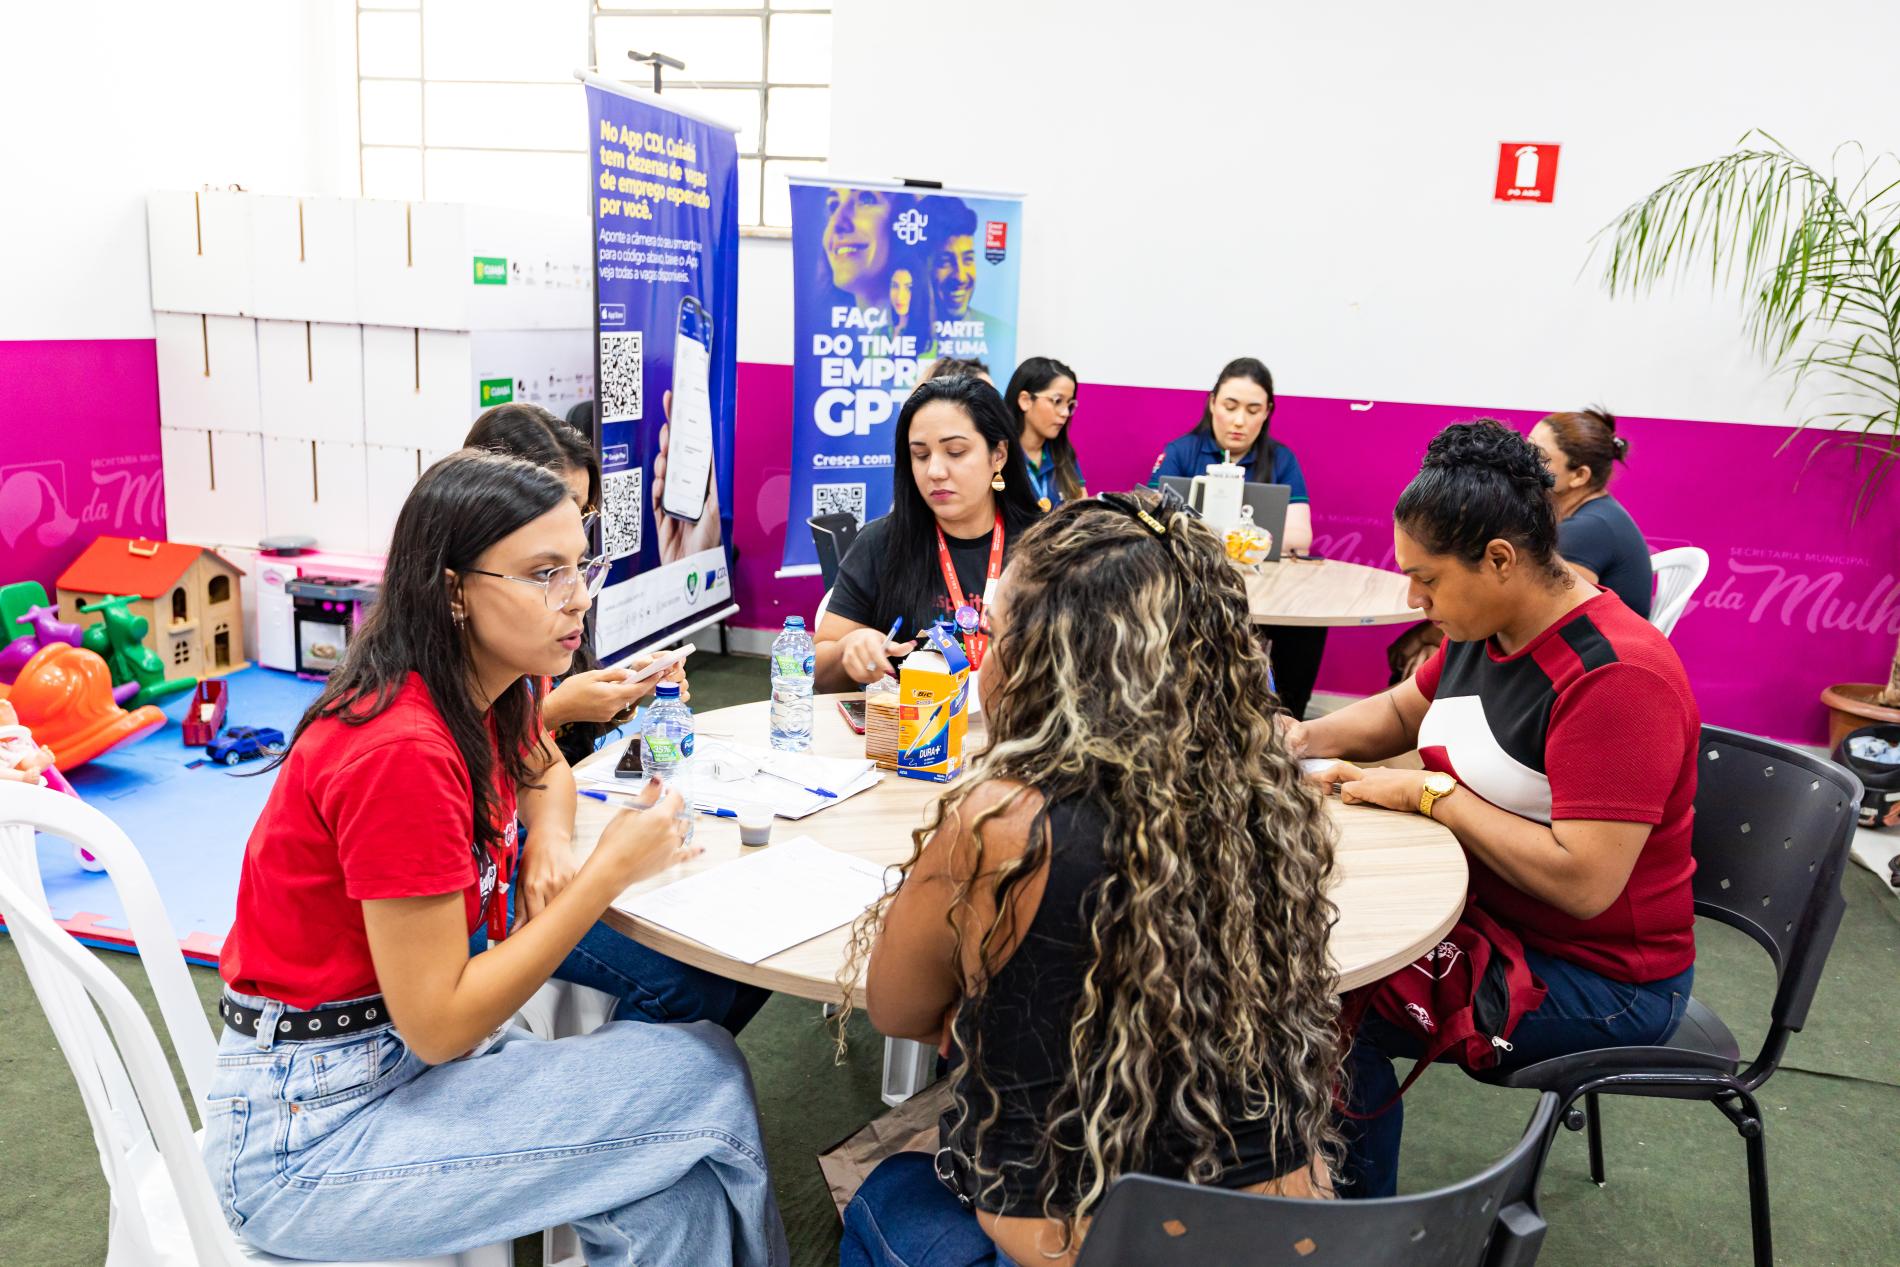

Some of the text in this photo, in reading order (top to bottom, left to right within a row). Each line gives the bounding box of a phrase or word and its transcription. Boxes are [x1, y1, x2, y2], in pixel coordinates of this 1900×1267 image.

[600, 119, 618, 143] No
[619, 125, 643, 153] App
[600, 145, 625, 169] tem
[626, 151, 668, 178] dezenas
[669, 160, 682, 181] de
[600, 168, 616, 191] de
[618, 176, 665, 203] emprego
[600, 197, 652, 220] por você.
[599, 227, 625, 244] Aponte
[600, 248, 616, 262] para
[617, 250, 622, 261] o
[679, 256, 685, 267] o
[599, 264, 615, 281] veja
[615, 265, 634, 280] todas
[812, 334, 853, 356] DO
[858, 335, 917, 356] TIME
[812, 454, 892, 468] Cresça com
[82, 469, 163, 528] da M
[1729, 547, 1870, 567] SECRETARIA MUNICIPAL
[1704, 575, 1745, 610] da
